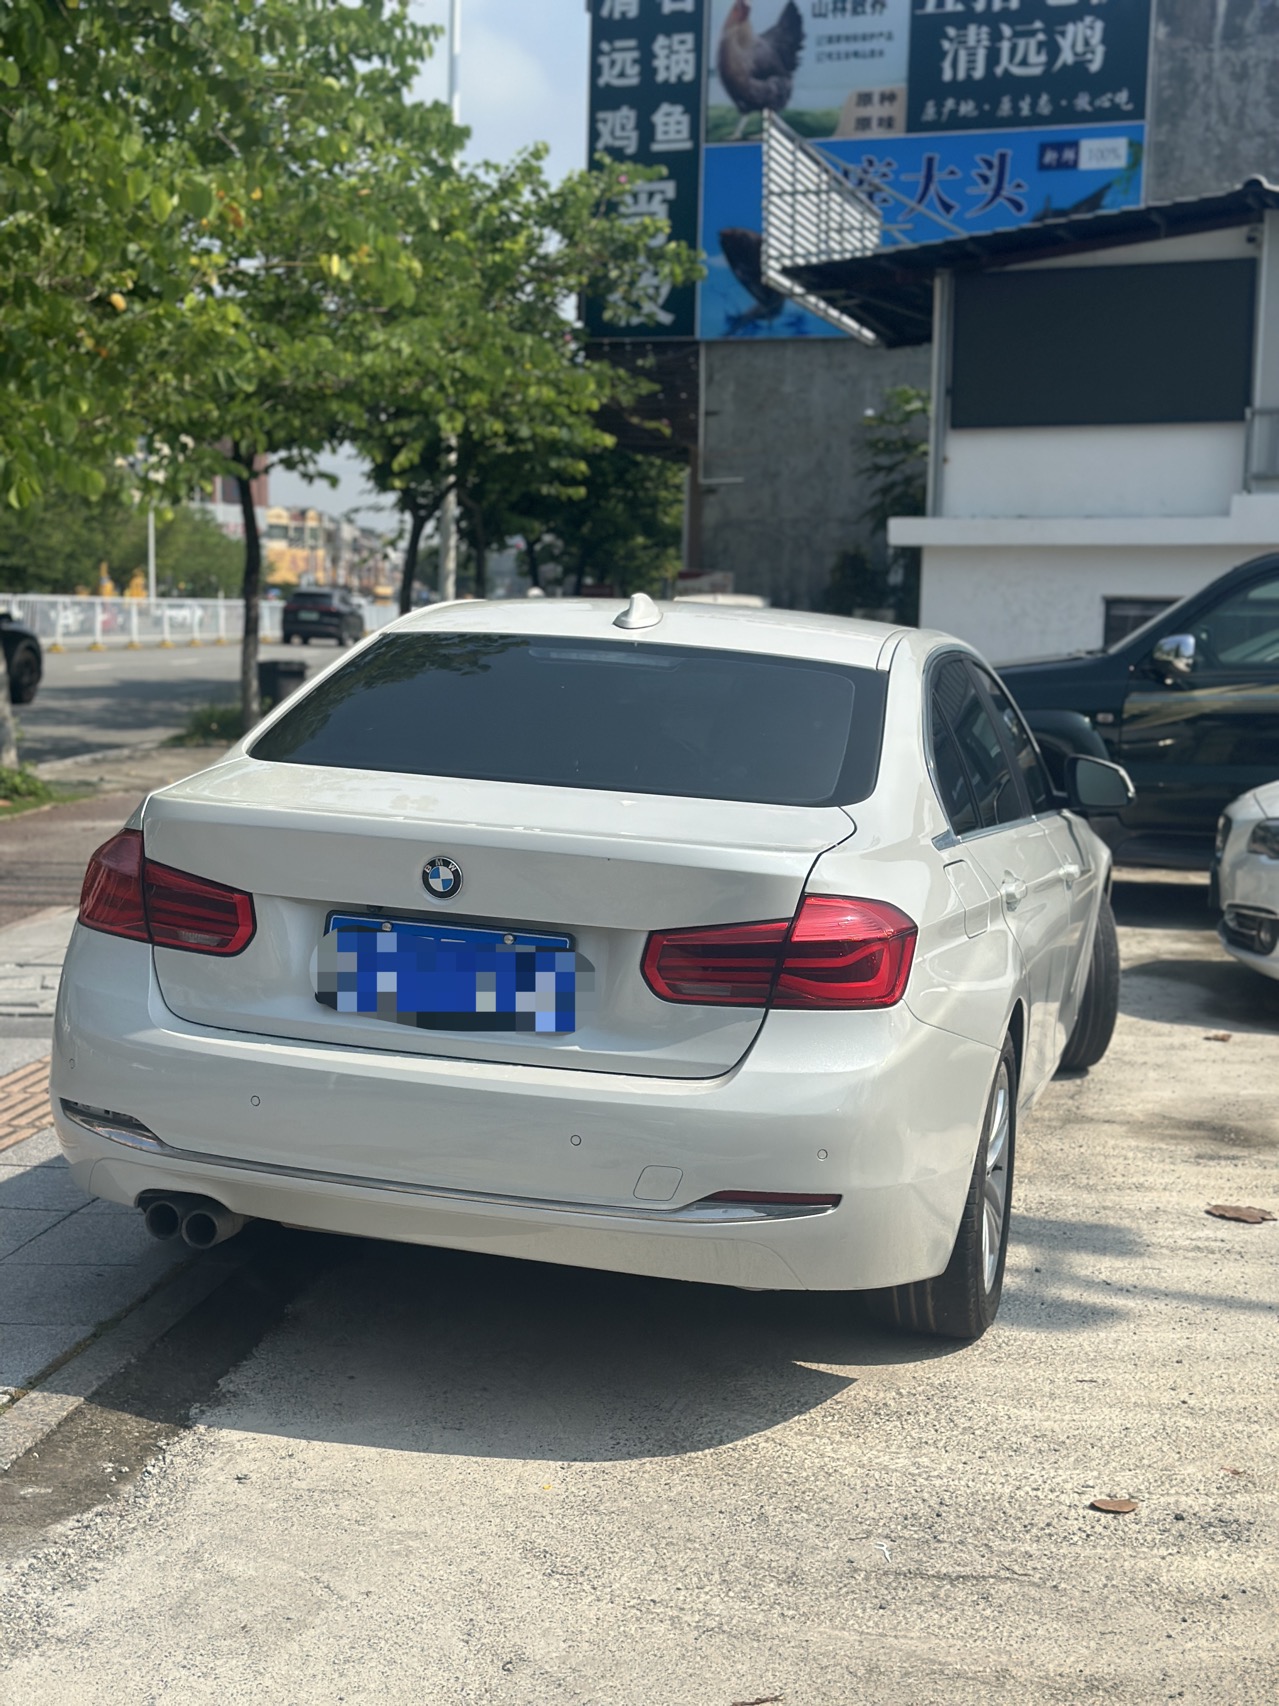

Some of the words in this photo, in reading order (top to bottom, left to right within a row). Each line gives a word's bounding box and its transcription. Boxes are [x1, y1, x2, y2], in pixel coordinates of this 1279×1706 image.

[941, 15, 1106, 82] 清远鸡
[424, 858, 457, 874] BMW
